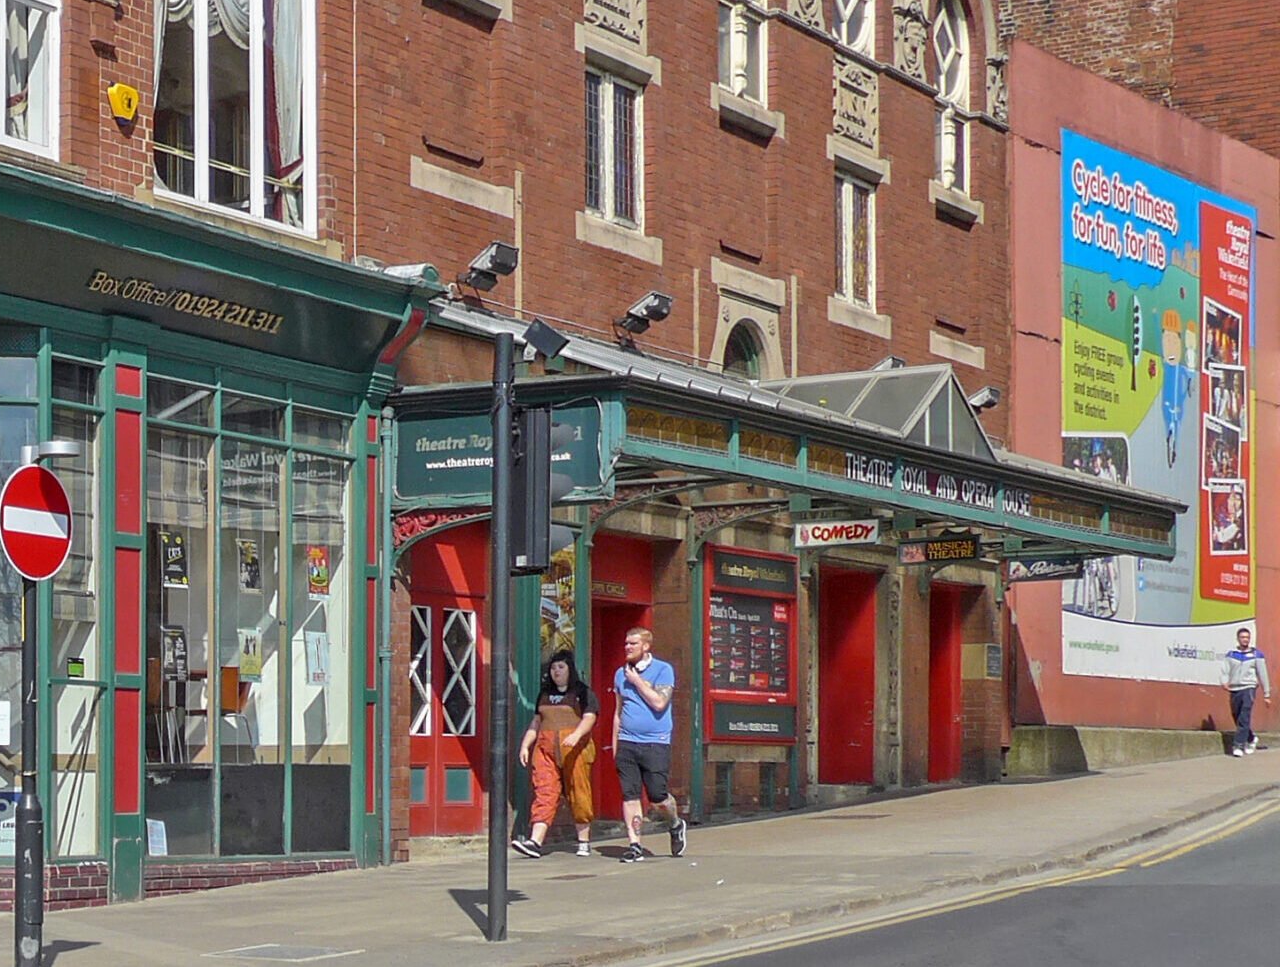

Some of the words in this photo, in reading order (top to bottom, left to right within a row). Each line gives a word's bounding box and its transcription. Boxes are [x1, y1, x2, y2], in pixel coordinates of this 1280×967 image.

[1072, 161, 1111, 206] Cycle
[1111, 176, 1133, 214] for
[1133, 182, 1179, 234] fitness,
[1072, 204, 1095, 241] for
[1095, 211, 1122, 258] fun,
[1123, 223, 1145, 257] for
[1145, 229, 1166, 269] life
[88, 271, 123, 296] Box
[224, 304, 254, 328] 211
[252, 311, 284, 334] 311
[1074, 340, 1091, 361] Enjoy
[1091, 345, 1107, 362] FREE
[1107, 353, 1124, 368] group
[1074, 362, 1094, 381] cycling
[1096, 368, 1115, 384] events
[1074, 381, 1085, 395] and
[1086, 385, 1112, 402] activities
[1113, 388, 1120, 404] in
[1074, 400, 1084, 414] the
[415, 436, 466, 453] theatre
[468, 434, 492, 451] Roy
[845, 452, 893, 488] THEATRE
[935, 475, 958, 501] AND
[961, 480, 994, 509] OPERA
[811, 523, 875, 541] COMEDY
[927, 539, 975, 552] MUSICAL
[927, 548, 974, 560] THEATRE
